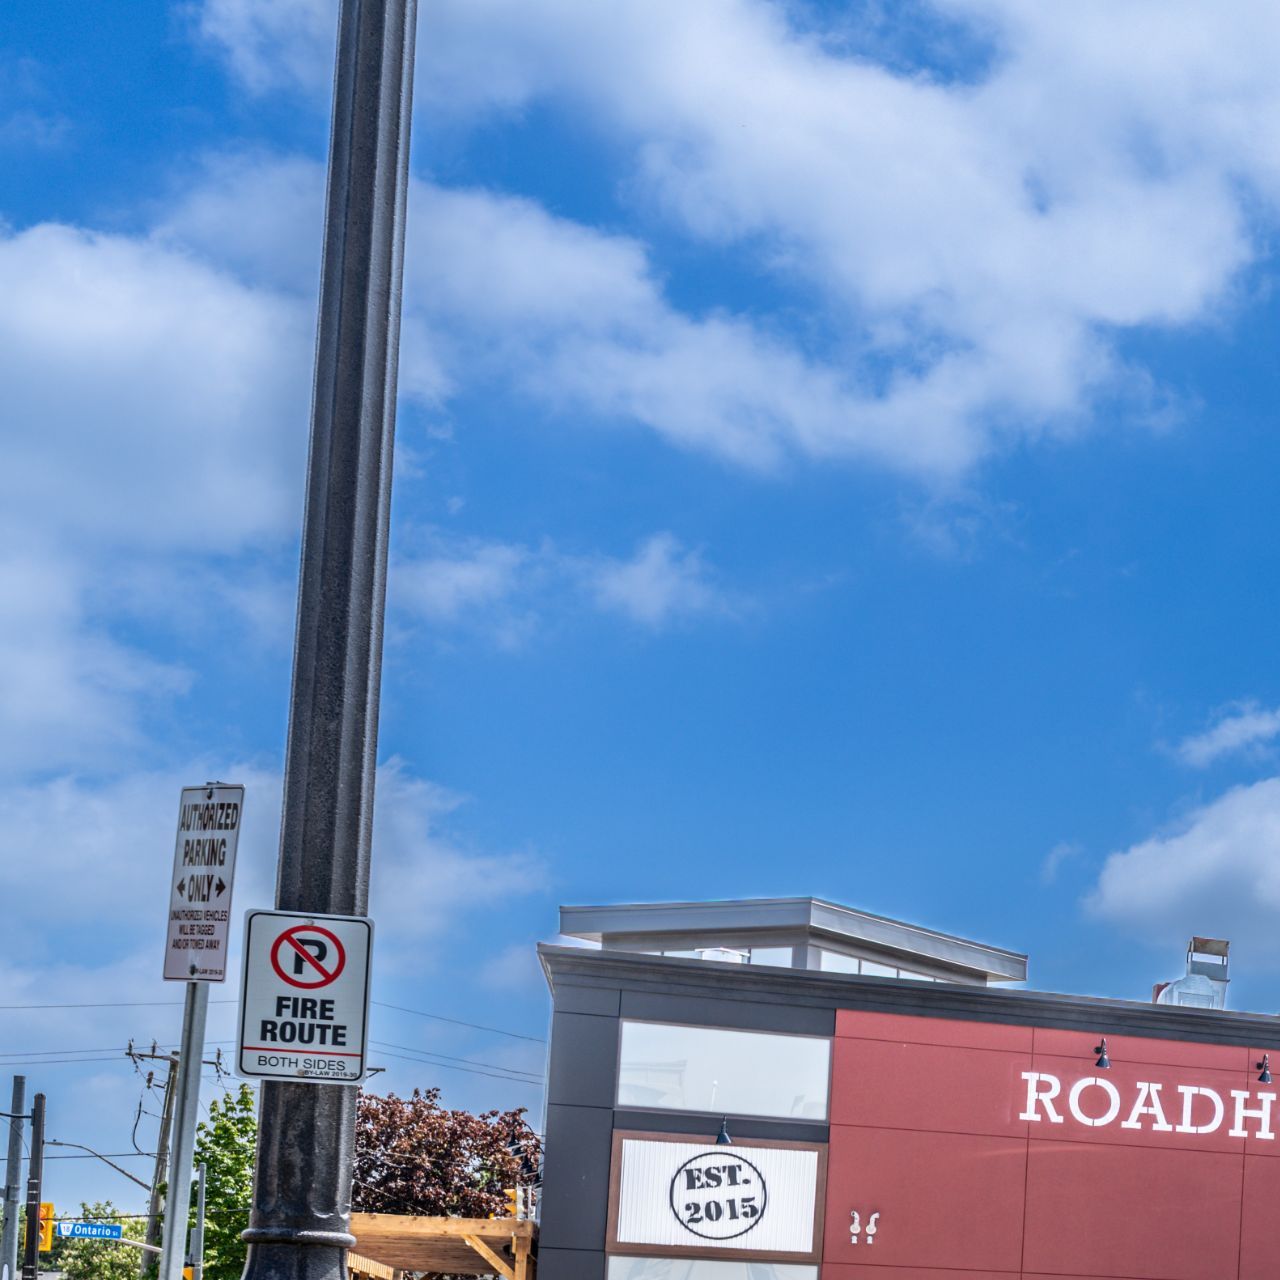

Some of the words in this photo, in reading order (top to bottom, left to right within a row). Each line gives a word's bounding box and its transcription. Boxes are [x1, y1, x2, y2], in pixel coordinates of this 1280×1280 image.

[180, 803, 239, 831] AUTHORIZED
[182, 838, 227, 866] PARKING
[188, 874, 214, 902] ONLY
[171, 910, 202, 921] UNAUTHORIZED
[203, 910, 228, 921] VEHICLES
[179, 924, 189, 935] WILL
[189, 924, 196, 935] BE
[196, 925, 215, 936] TAGGED
[189, 939, 205, 950] TOWED
[205, 939, 220, 950] AWAY
[275, 995, 335, 1021] FIRE
[260, 1019, 347, 1046] ROUTE
[257, 1055, 299, 1068] BOTH
[303, 1058, 346, 1071] SIDES
[684, 1164, 751, 1191] EST.
[684, 1196, 760, 1224] 2015
[74, 1225, 111, 1236] Ontario
